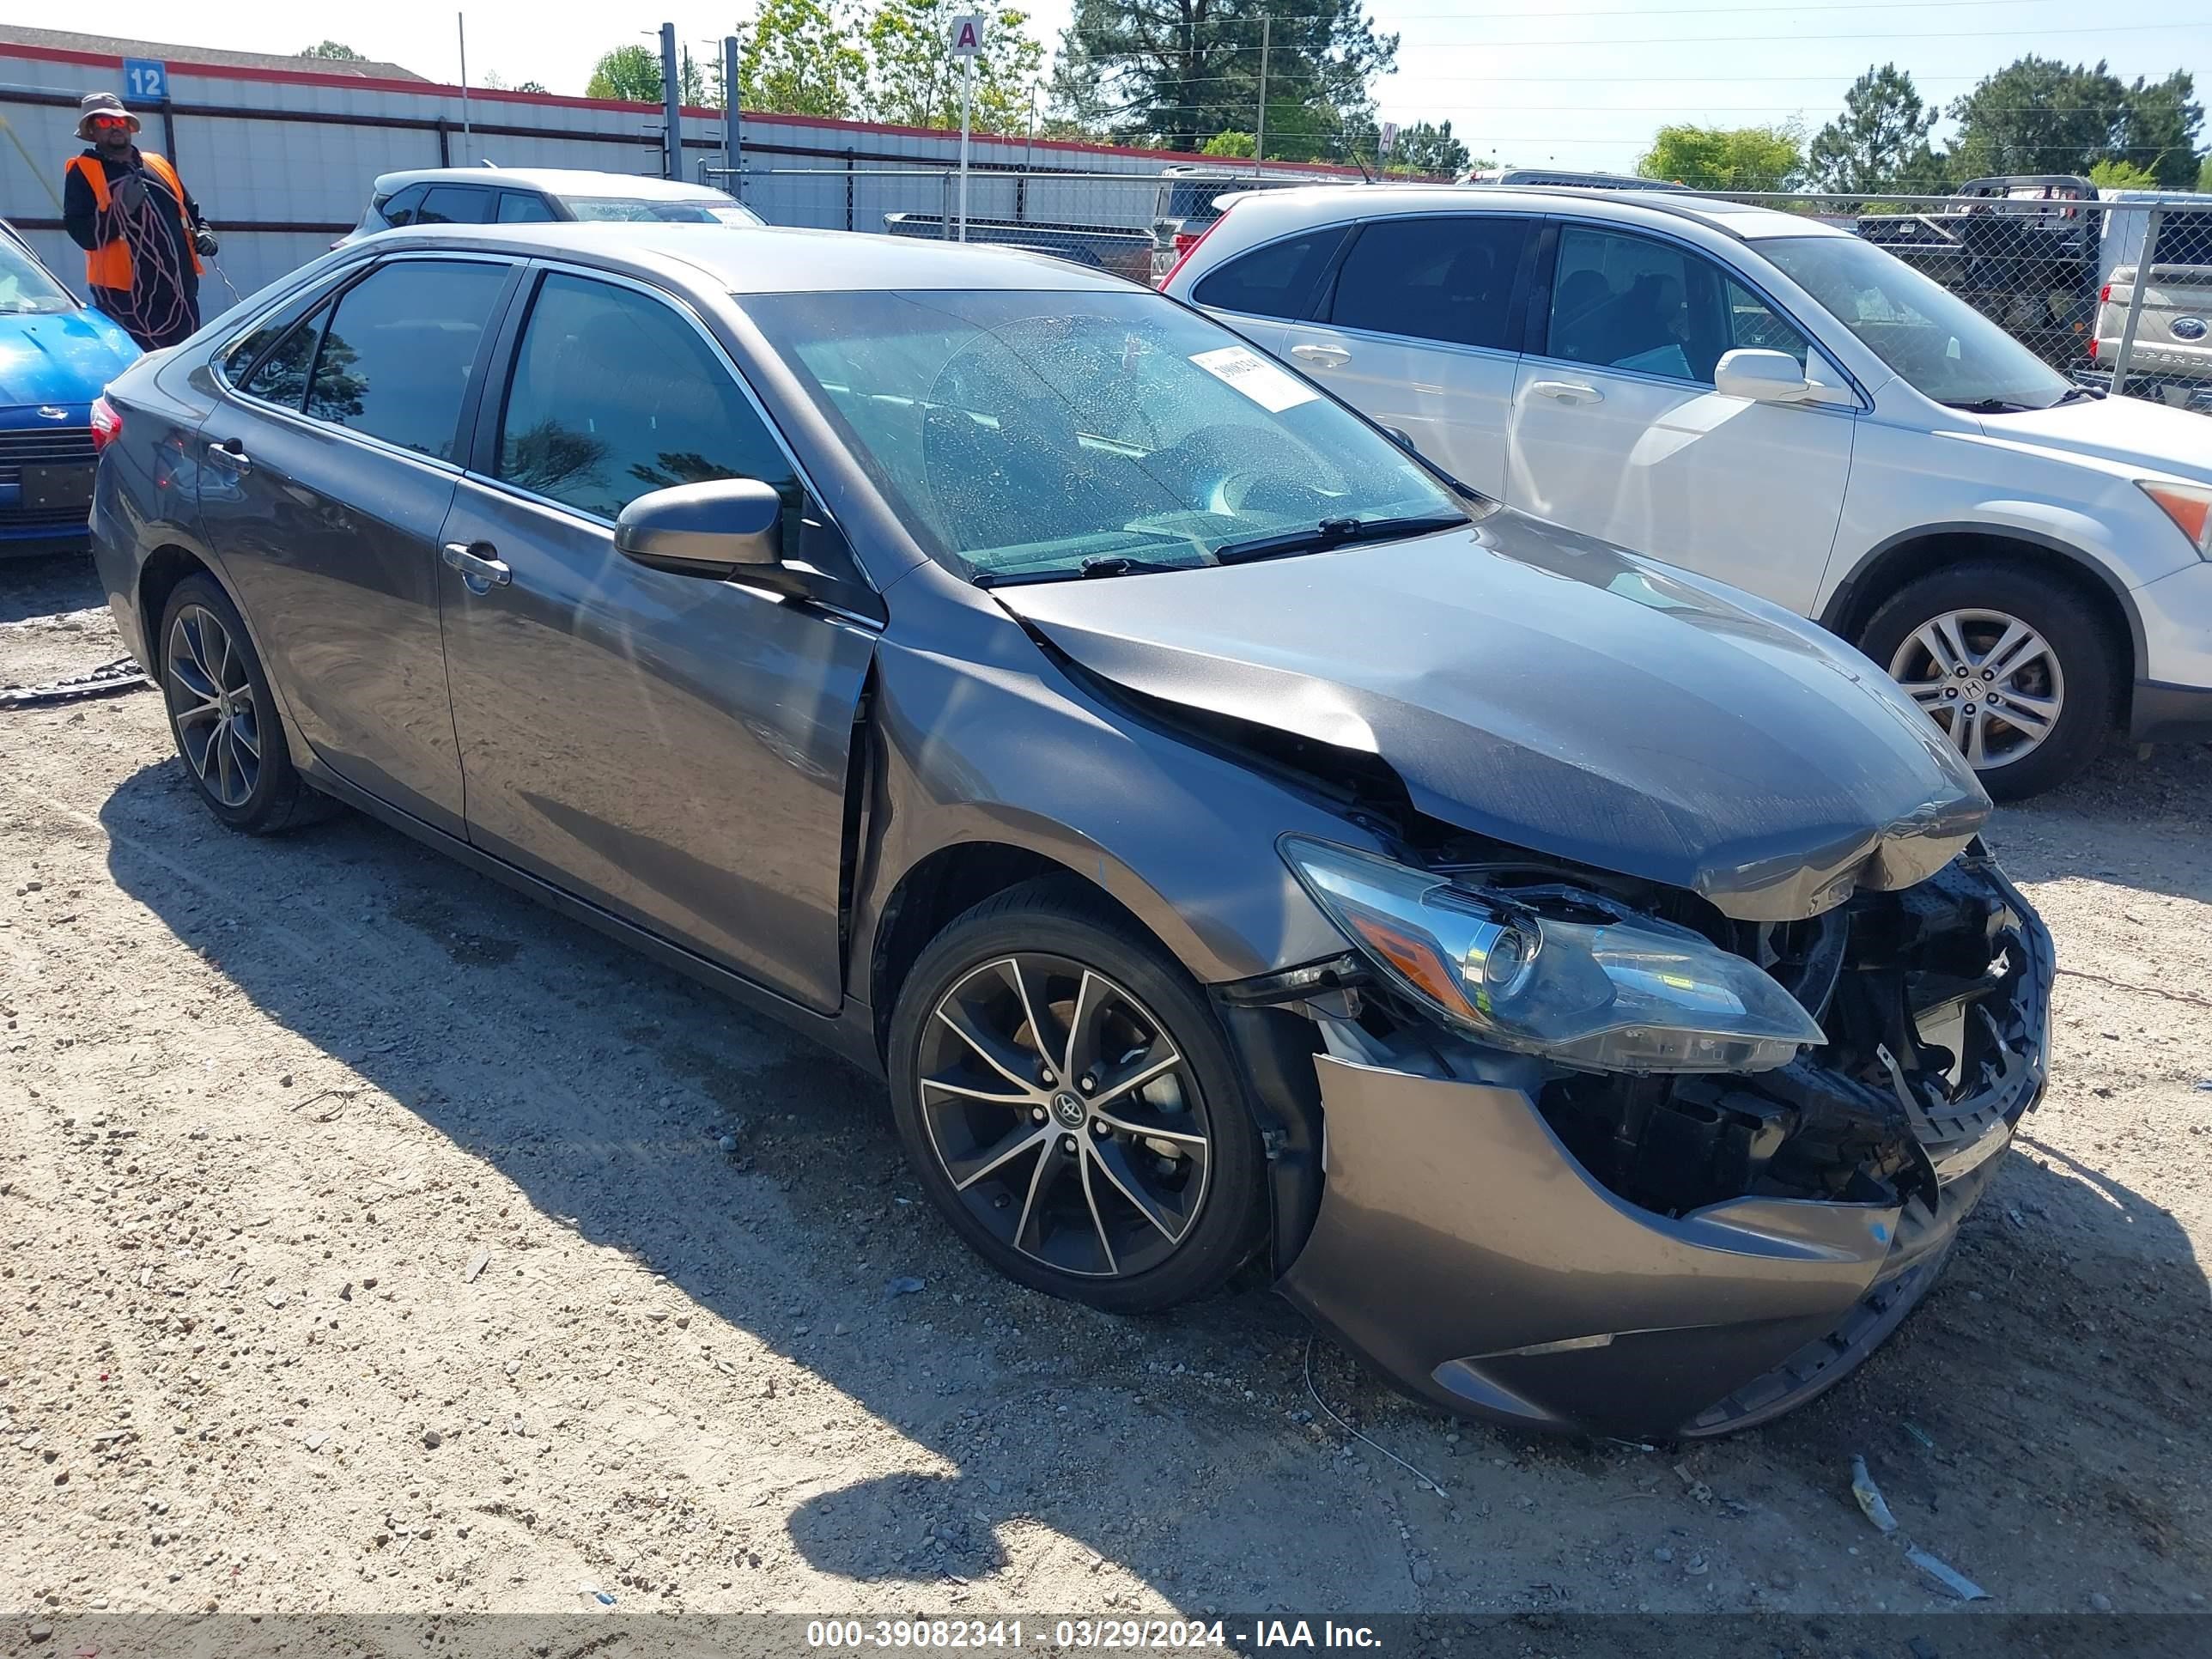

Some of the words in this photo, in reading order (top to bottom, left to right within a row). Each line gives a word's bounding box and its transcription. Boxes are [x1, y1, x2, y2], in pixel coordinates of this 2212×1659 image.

[957, 22, 977, 48] A
[131, 68, 161, 95] 12
[1379, 124, 1393, 152] A
[2131, 349, 2185, 364] UPER
